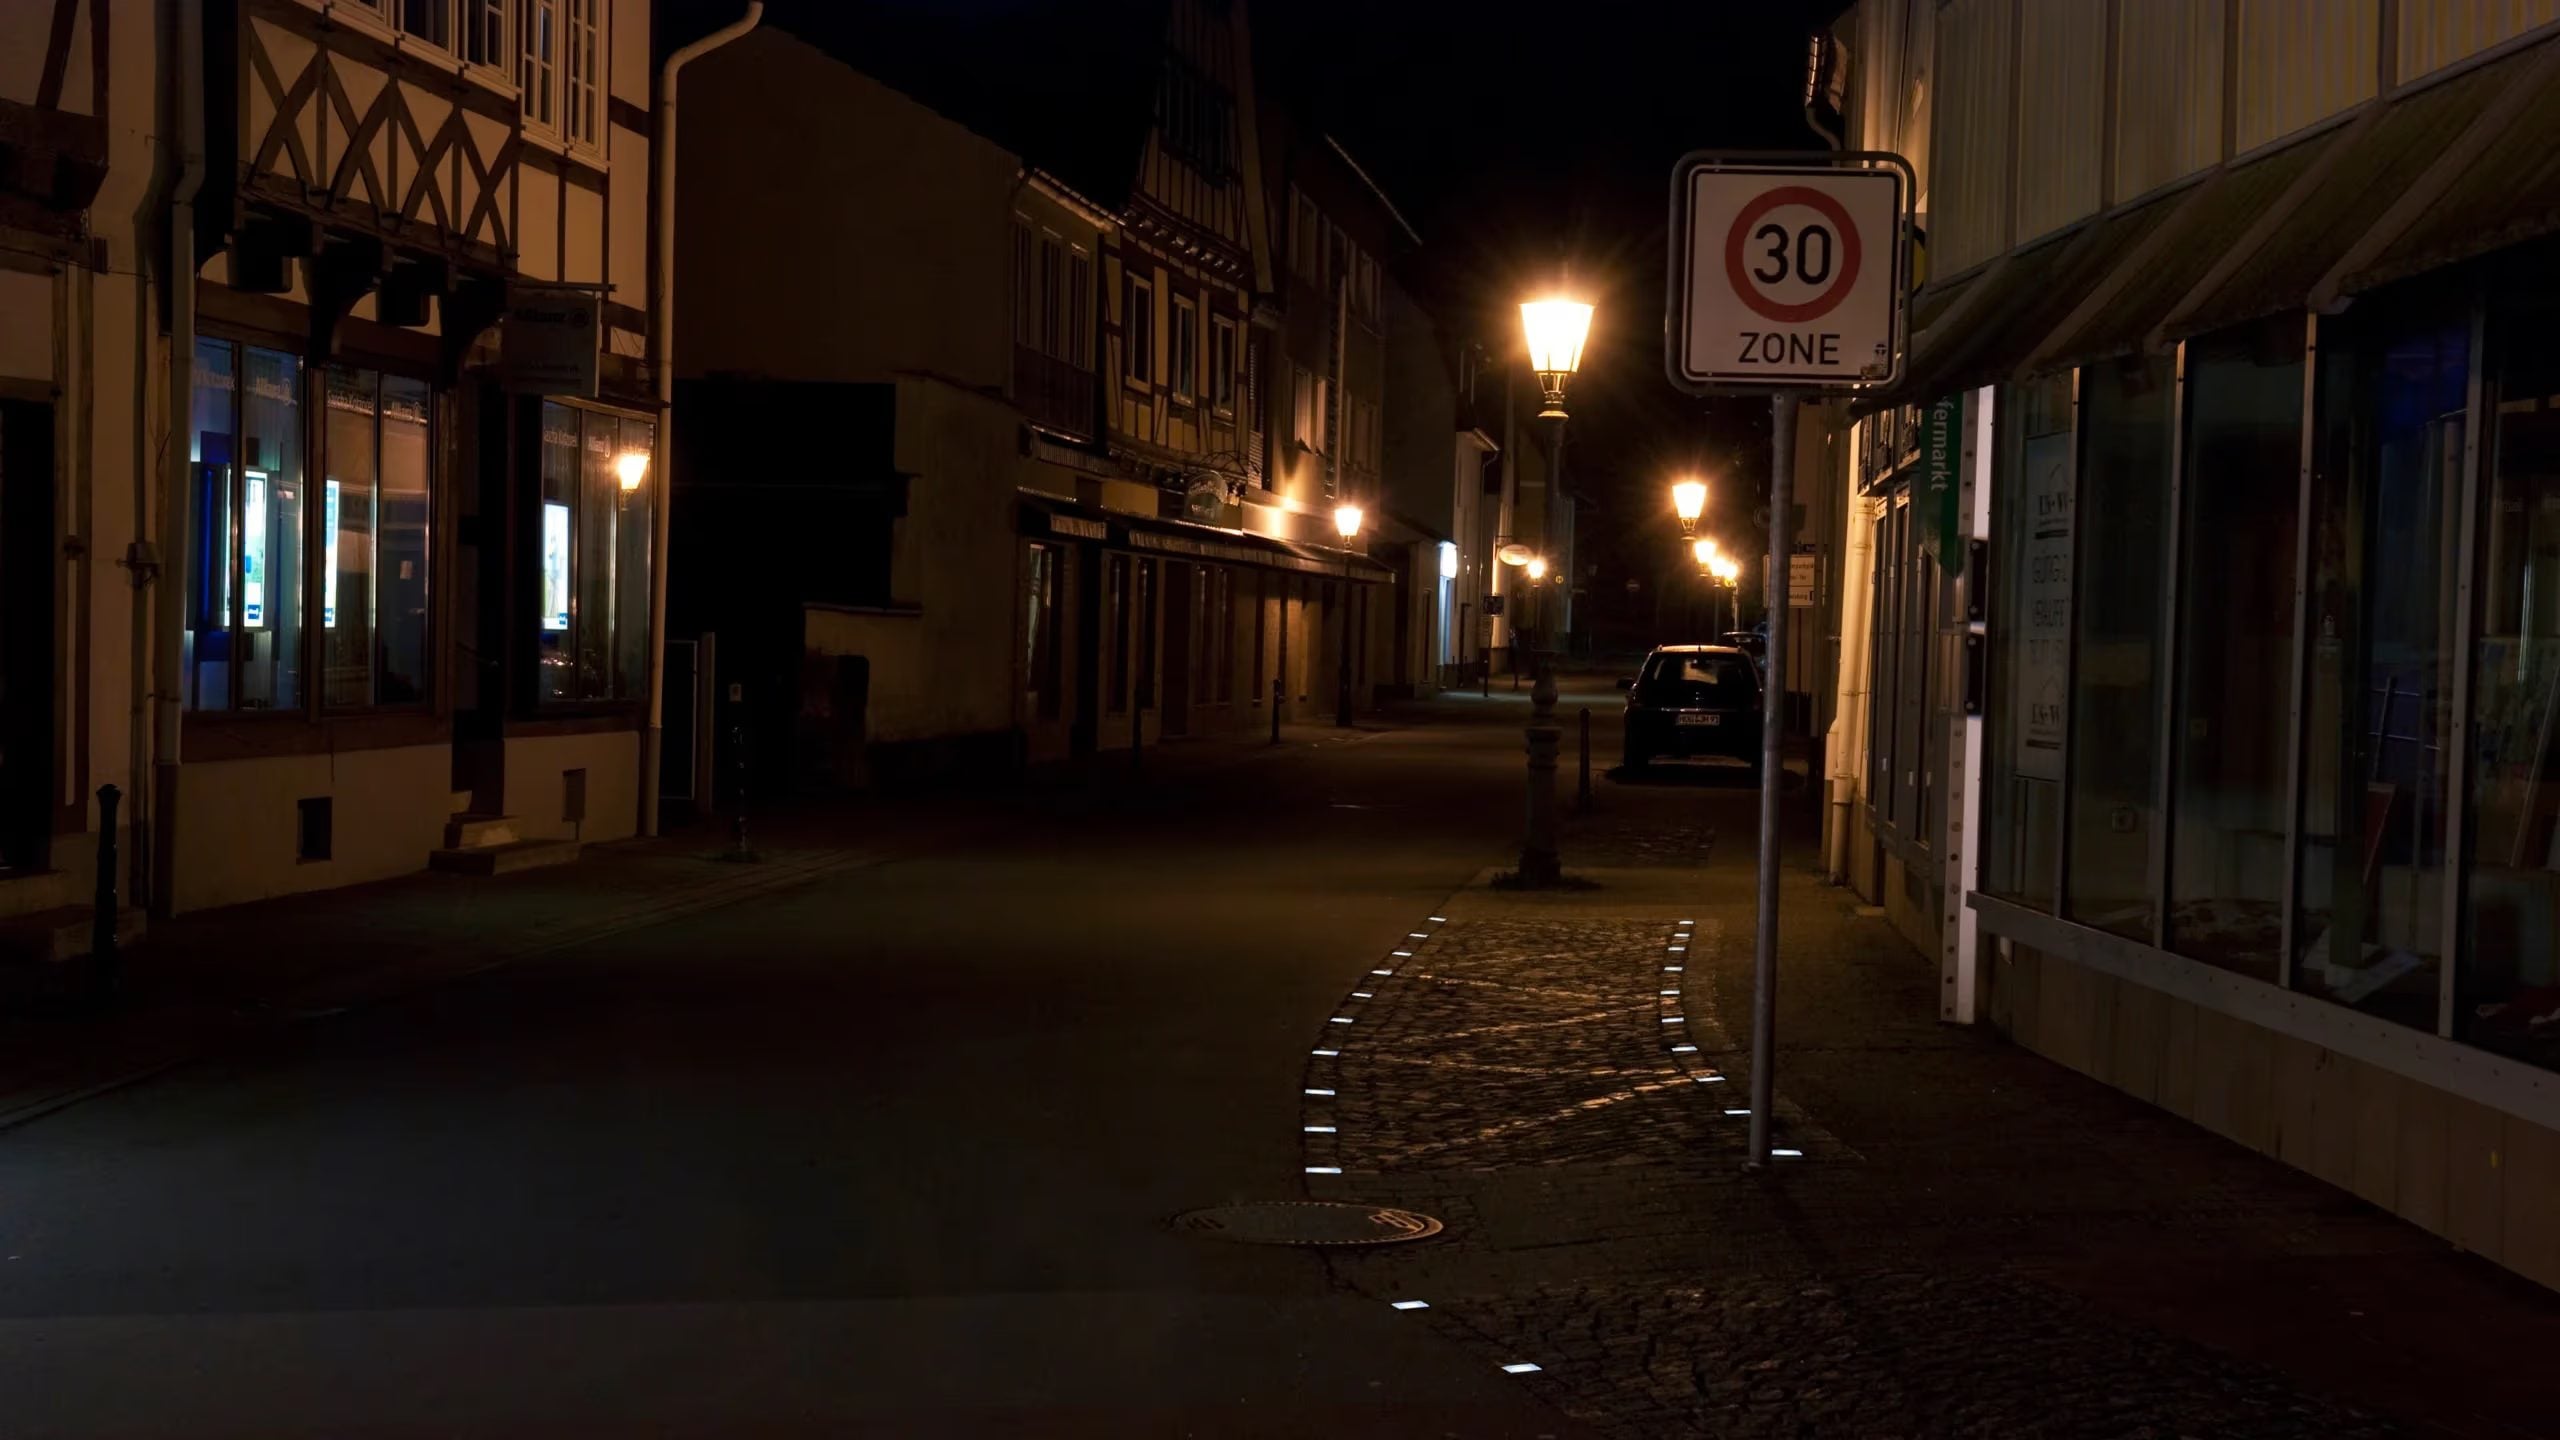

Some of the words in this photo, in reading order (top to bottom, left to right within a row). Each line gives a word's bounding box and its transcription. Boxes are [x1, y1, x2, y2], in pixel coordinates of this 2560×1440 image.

[1754, 224, 1832, 285] 30
[1738, 332, 1841, 365] ZONE
[1930, 394, 1955, 492] fermarkt
